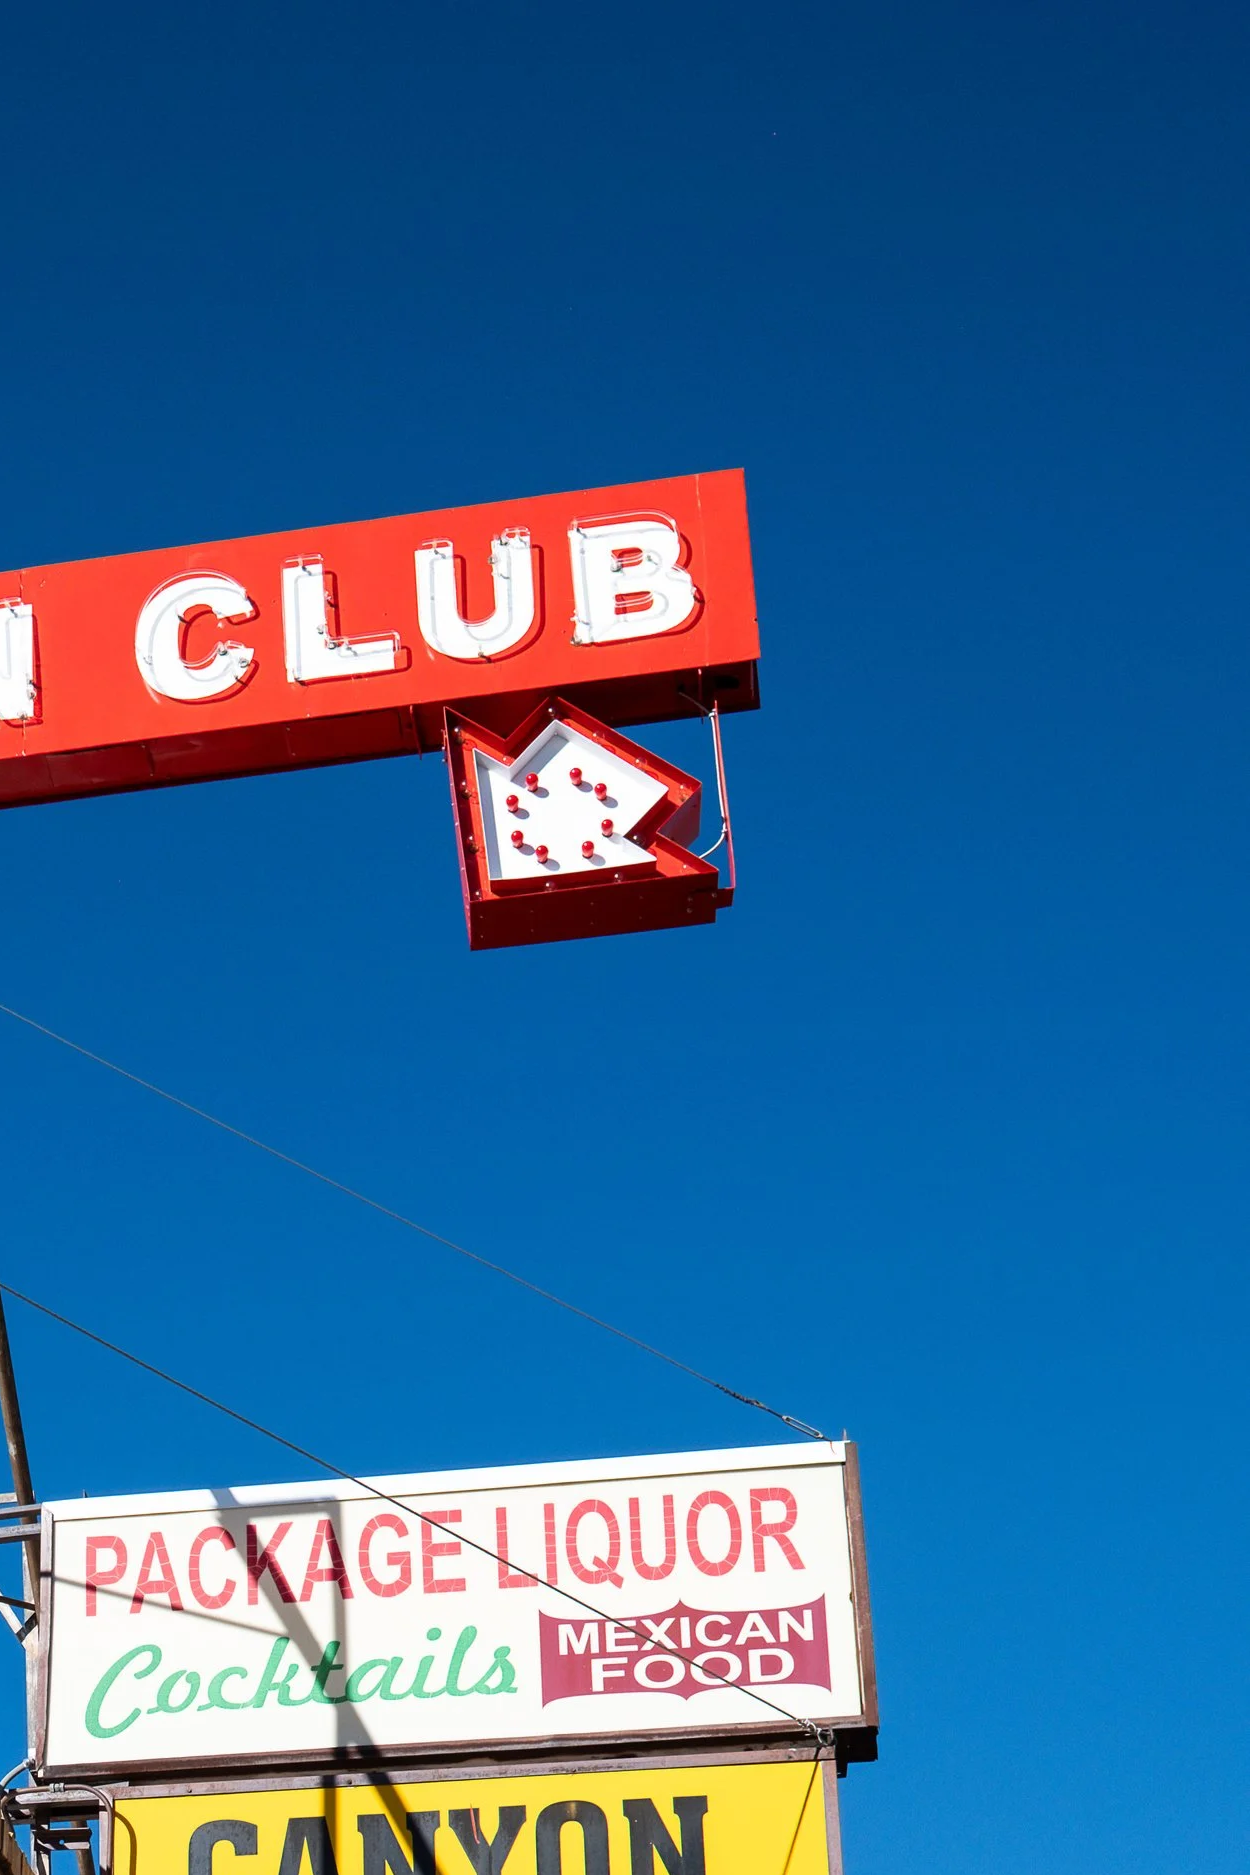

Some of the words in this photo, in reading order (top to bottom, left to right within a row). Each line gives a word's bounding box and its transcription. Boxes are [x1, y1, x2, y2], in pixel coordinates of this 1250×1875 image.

[135, 510, 700, 700] CLUB
[85, 1508, 465, 1616] PACKAGE
[496, 1487, 804, 1588] LIQUOR
[85, 1624, 517, 1739] Cocktails
[557, 1607, 815, 1656] MEXICAN
[591, 1645, 796, 1692] FOOD
